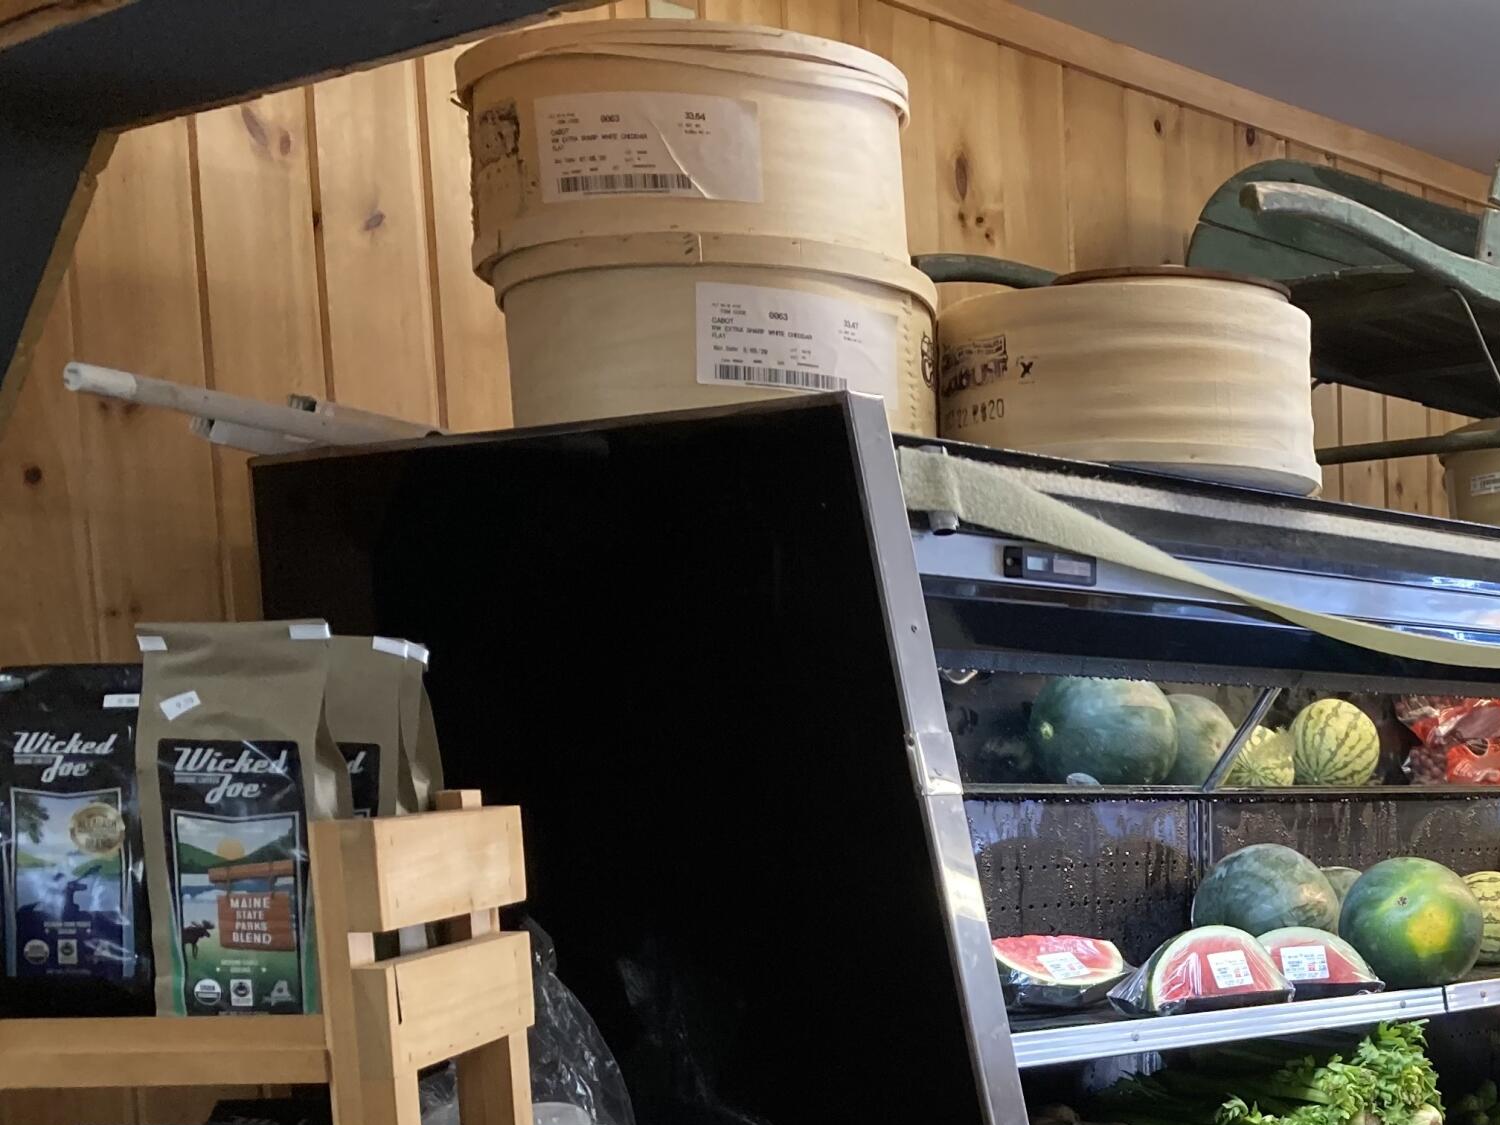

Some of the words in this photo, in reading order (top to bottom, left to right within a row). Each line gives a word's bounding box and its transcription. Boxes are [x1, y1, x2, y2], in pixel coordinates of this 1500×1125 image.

[13, 731, 118, 755] Wicked
[41, 755, 90, 783] Joe
[173, 747, 288, 774] Wicked
[205, 773, 262, 804] Joe
[230, 897, 270, 909] MAINE
[236, 910, 264, 920] STATE
[235, 921, 268, 932] PARKS
[232, 932, 272, 945] BLEND
